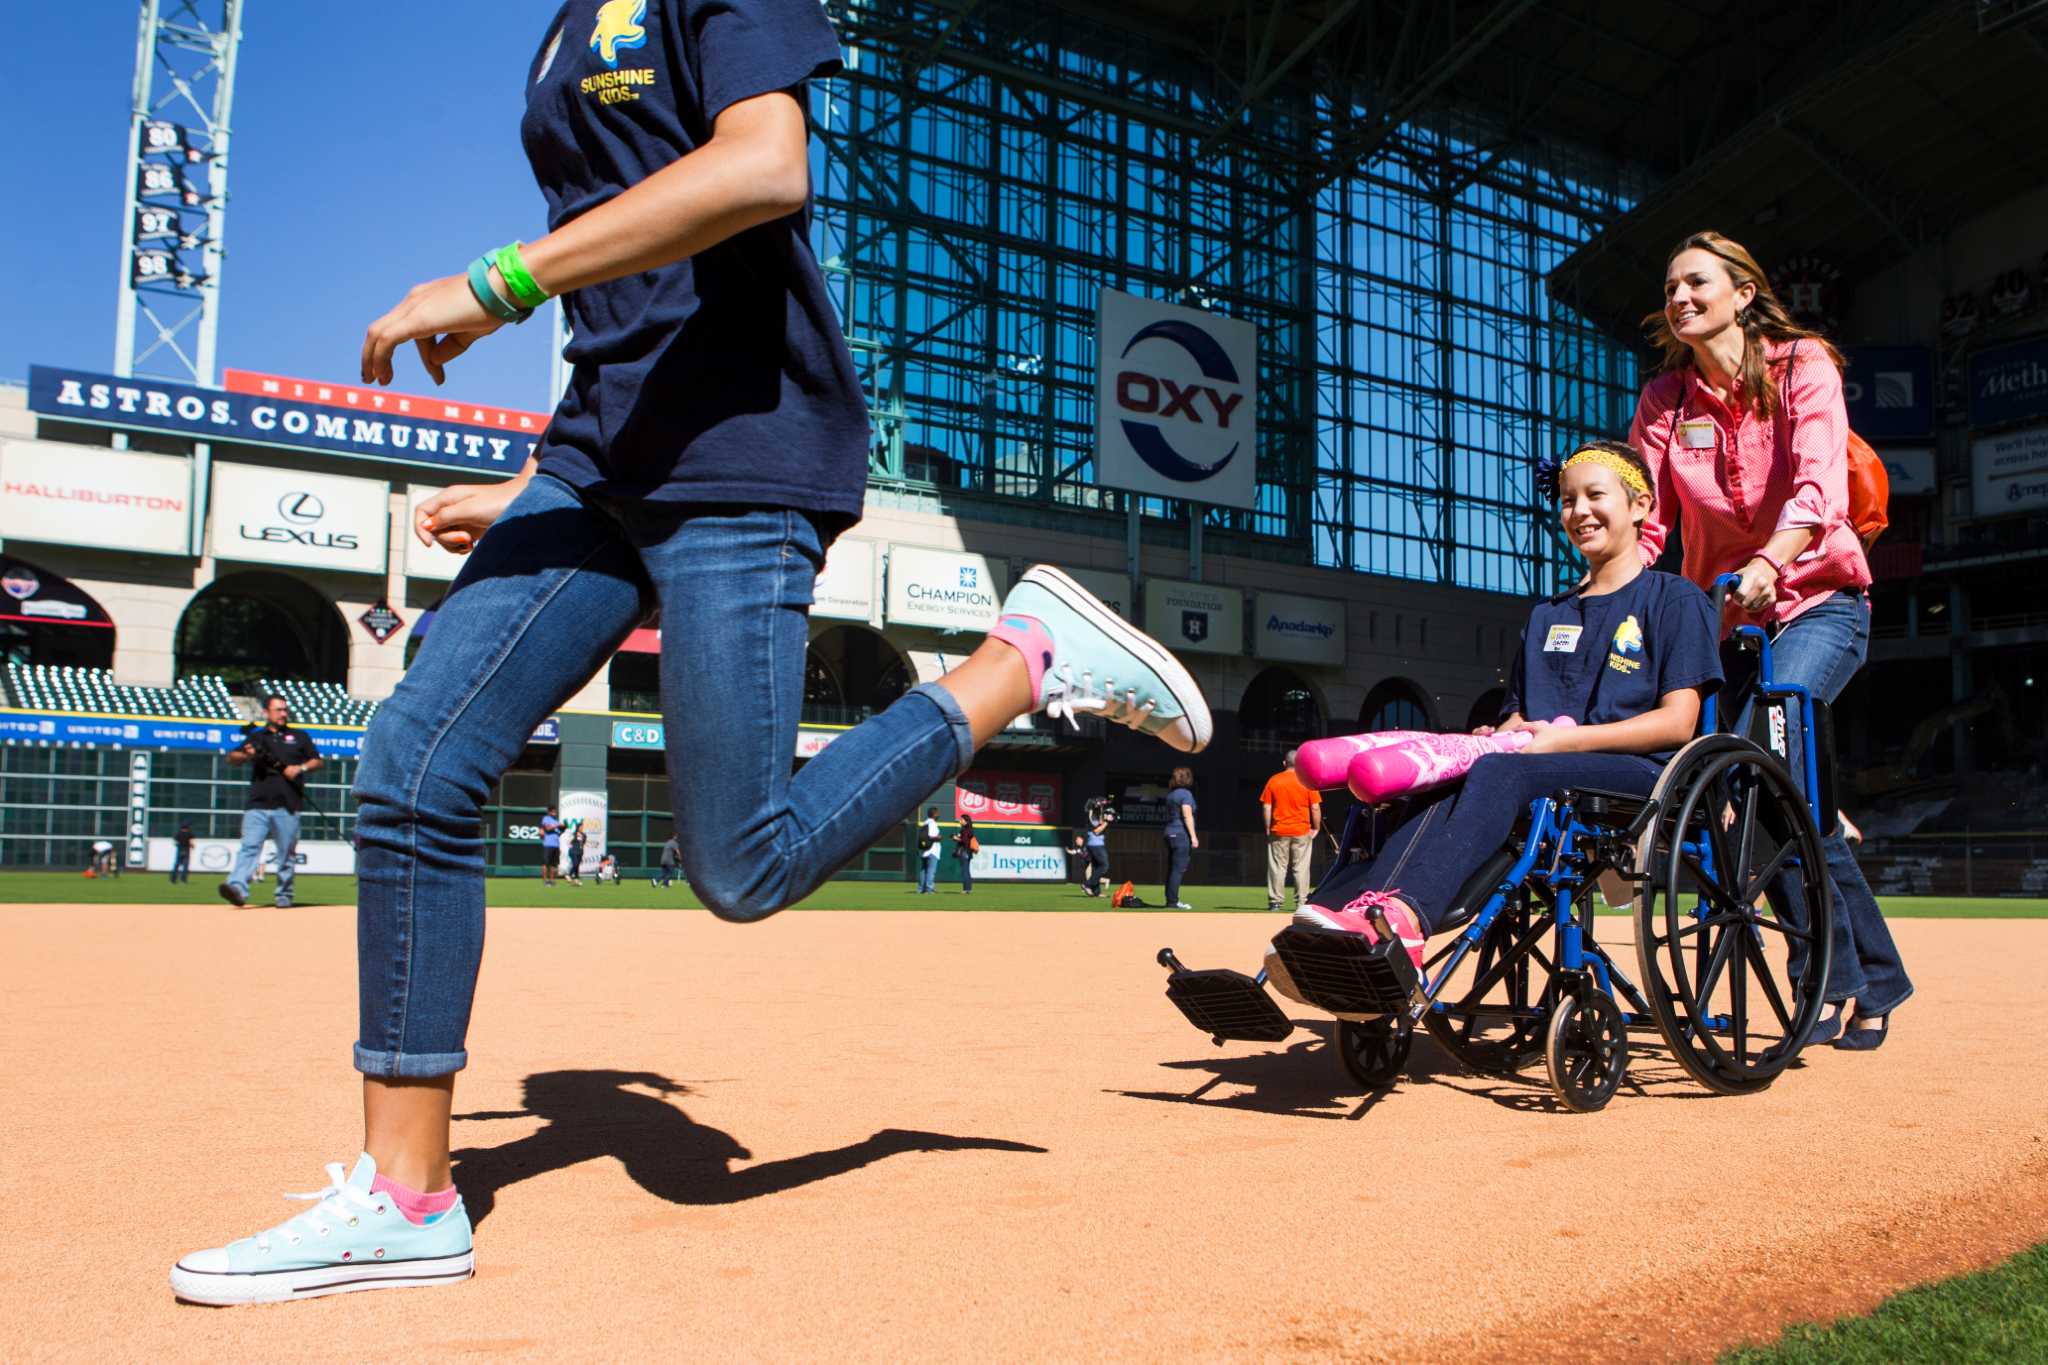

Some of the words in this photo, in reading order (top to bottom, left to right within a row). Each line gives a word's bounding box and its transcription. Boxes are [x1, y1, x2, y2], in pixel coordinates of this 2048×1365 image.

[580, 68, 656, 94] SUNSHINE
[262, 379, 411, 412] MINUTE
[1116, 370, 1243, 428] OXY
[250, 405, 511, 461] COMMUNITY
[4, 481, 184, 512] HALLIBURTON
[239, 524, 359, 550] LEXUS
[907, 583, 993, 606] CHAMPION
[907, 601, 945, 614] ENERGY
[946, 605, 993, 619] SERVICES
[67, 725, 123, 736] UNITED
[153, 729, 206, 740] UNITED
[130, 755, 147, 863] AMERICAN
[508, 825, 541, 839] 362
[1013, 836, 1032, 845] 404
[992, 853, 1062, 876] Insperity
